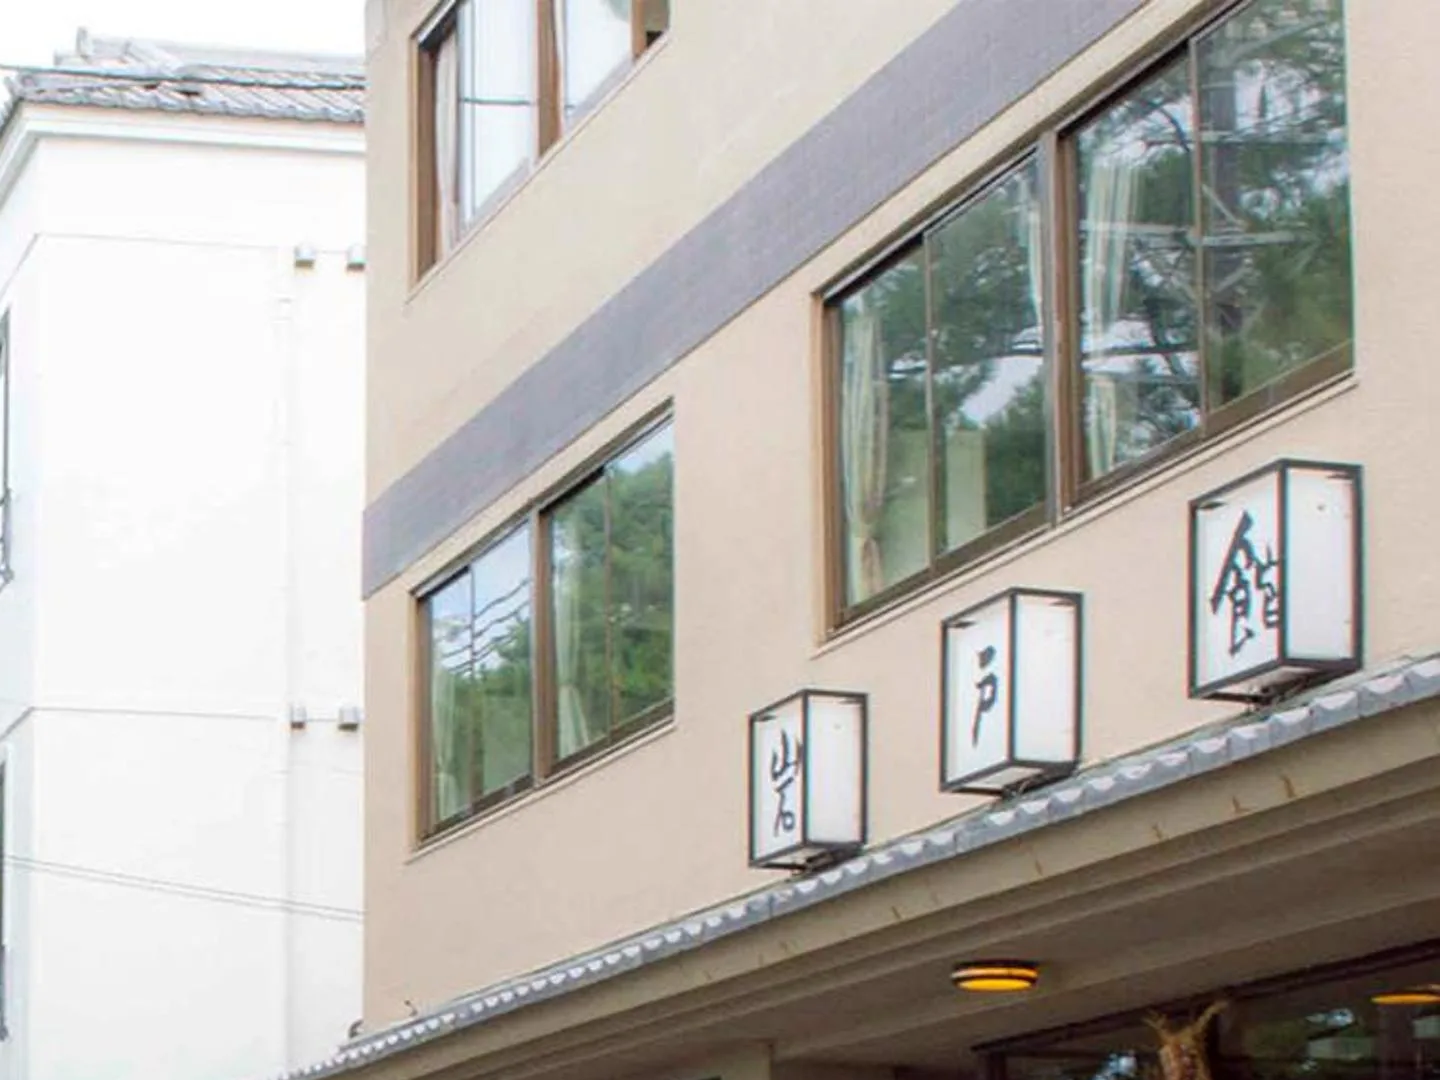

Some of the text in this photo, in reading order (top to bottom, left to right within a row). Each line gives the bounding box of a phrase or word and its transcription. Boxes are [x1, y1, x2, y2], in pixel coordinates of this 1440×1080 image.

[771, 510, 1278, 838] 岩 戸 館
